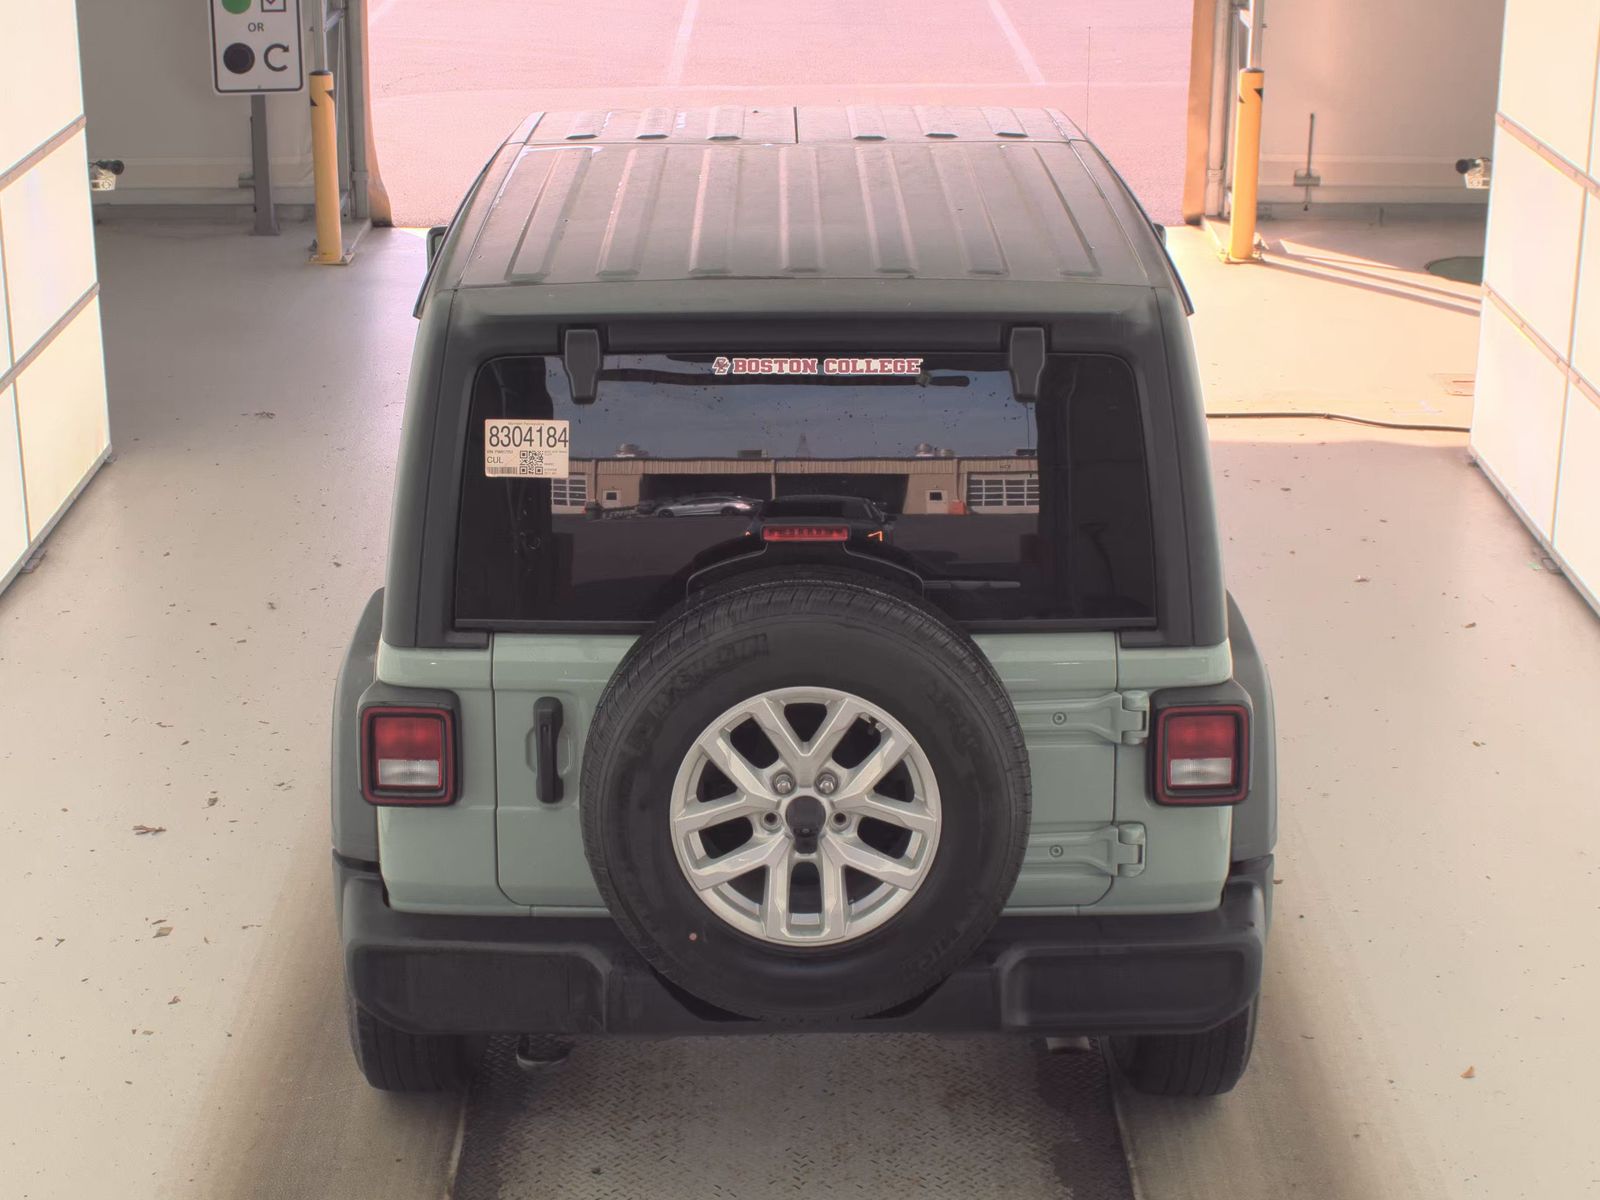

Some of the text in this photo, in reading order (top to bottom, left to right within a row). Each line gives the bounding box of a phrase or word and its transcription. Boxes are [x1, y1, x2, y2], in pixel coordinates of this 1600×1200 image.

[247, 22, 265, 32] OR
[733, 358, 922, 376] BOSTON COLLEGE
[489, 425, 569, 448] 8304184
[486, 456, 503, 464] CUL
